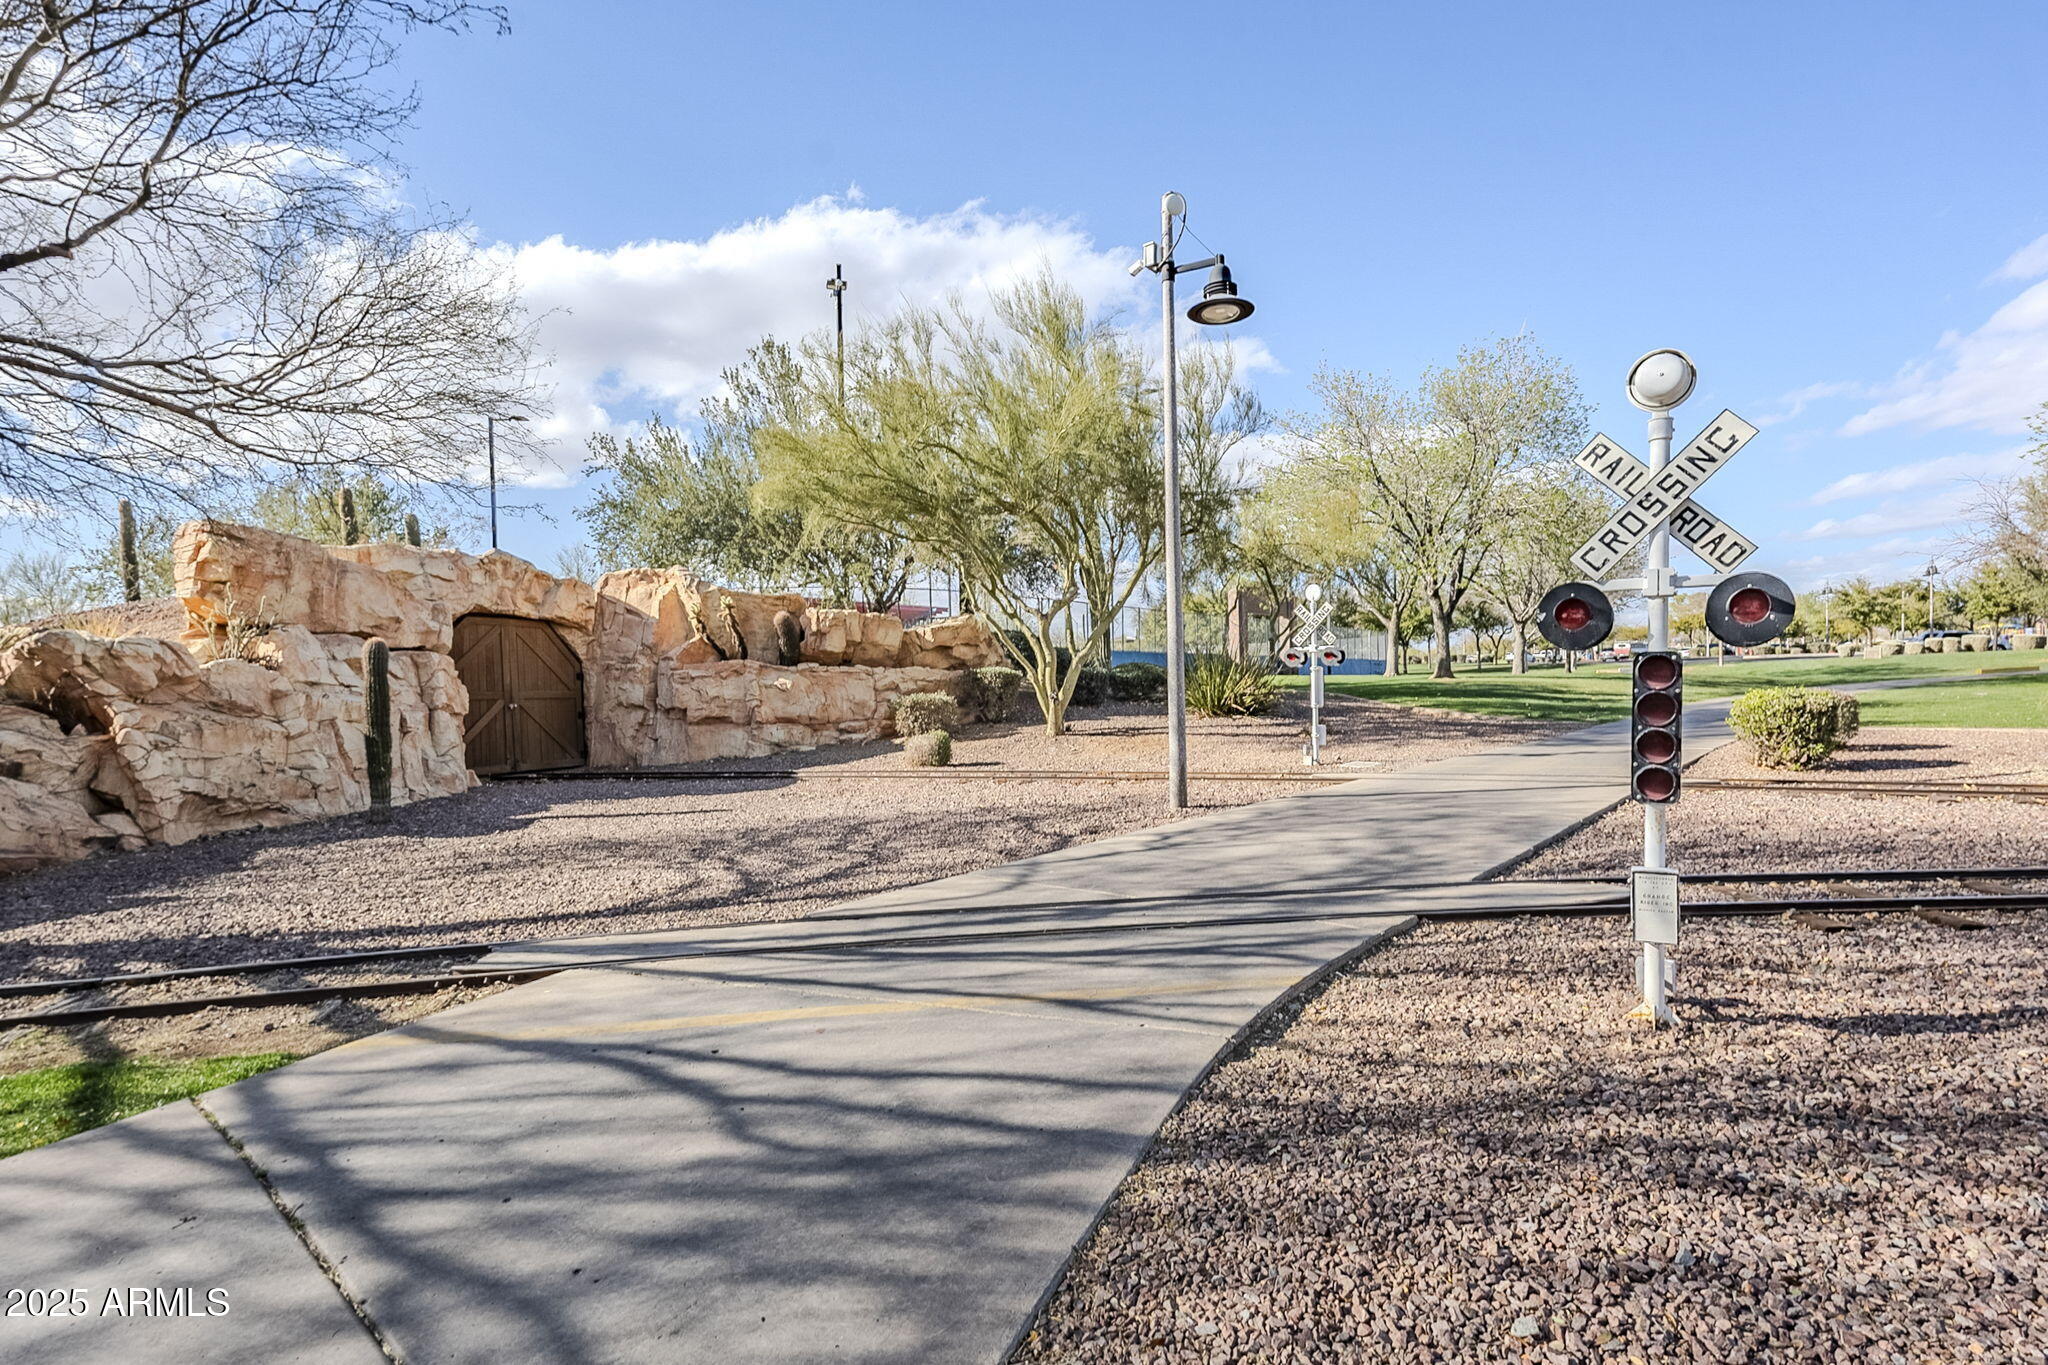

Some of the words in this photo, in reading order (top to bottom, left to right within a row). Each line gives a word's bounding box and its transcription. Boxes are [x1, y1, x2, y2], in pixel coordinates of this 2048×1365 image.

[1580, 426, 1740, 573] CROSSING
[1582, 442, 1648, 499] RAIL
[1670, 506, 1748, 567] ROAD
[1294, 605, 1330, 645] CROSSING
[1296, 605, 1311, 622] RAIL
[1317, 625, 1335, 644] ROAD
